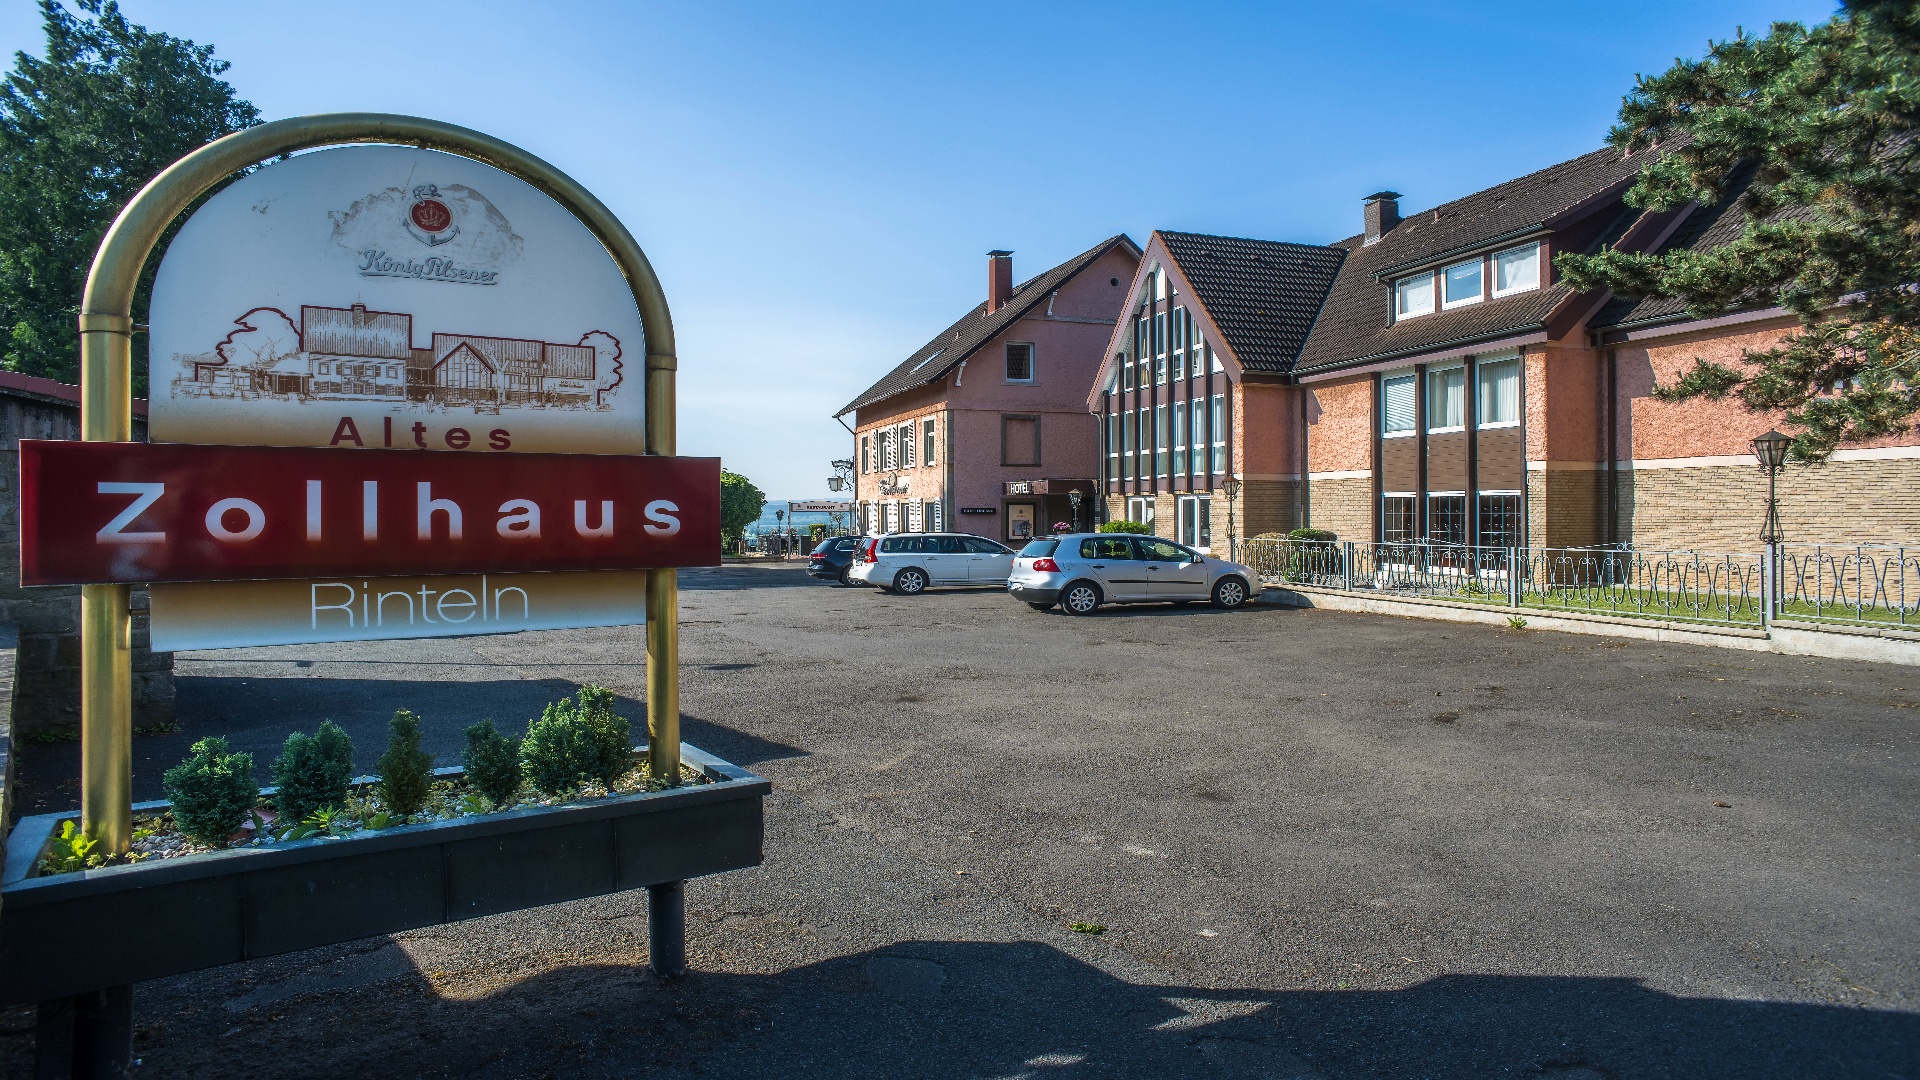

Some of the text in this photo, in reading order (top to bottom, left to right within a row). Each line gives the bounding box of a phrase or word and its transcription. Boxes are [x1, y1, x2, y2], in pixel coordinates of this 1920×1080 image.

[358, 250, 499, 281] König Pilsener
[329, 416, 512, 450] Altes
[1010, 483, 1030, 495] HOTEL
[96, 480, 682, 544] Zollhaus
[311, 574, 529, 630] Rinteln
